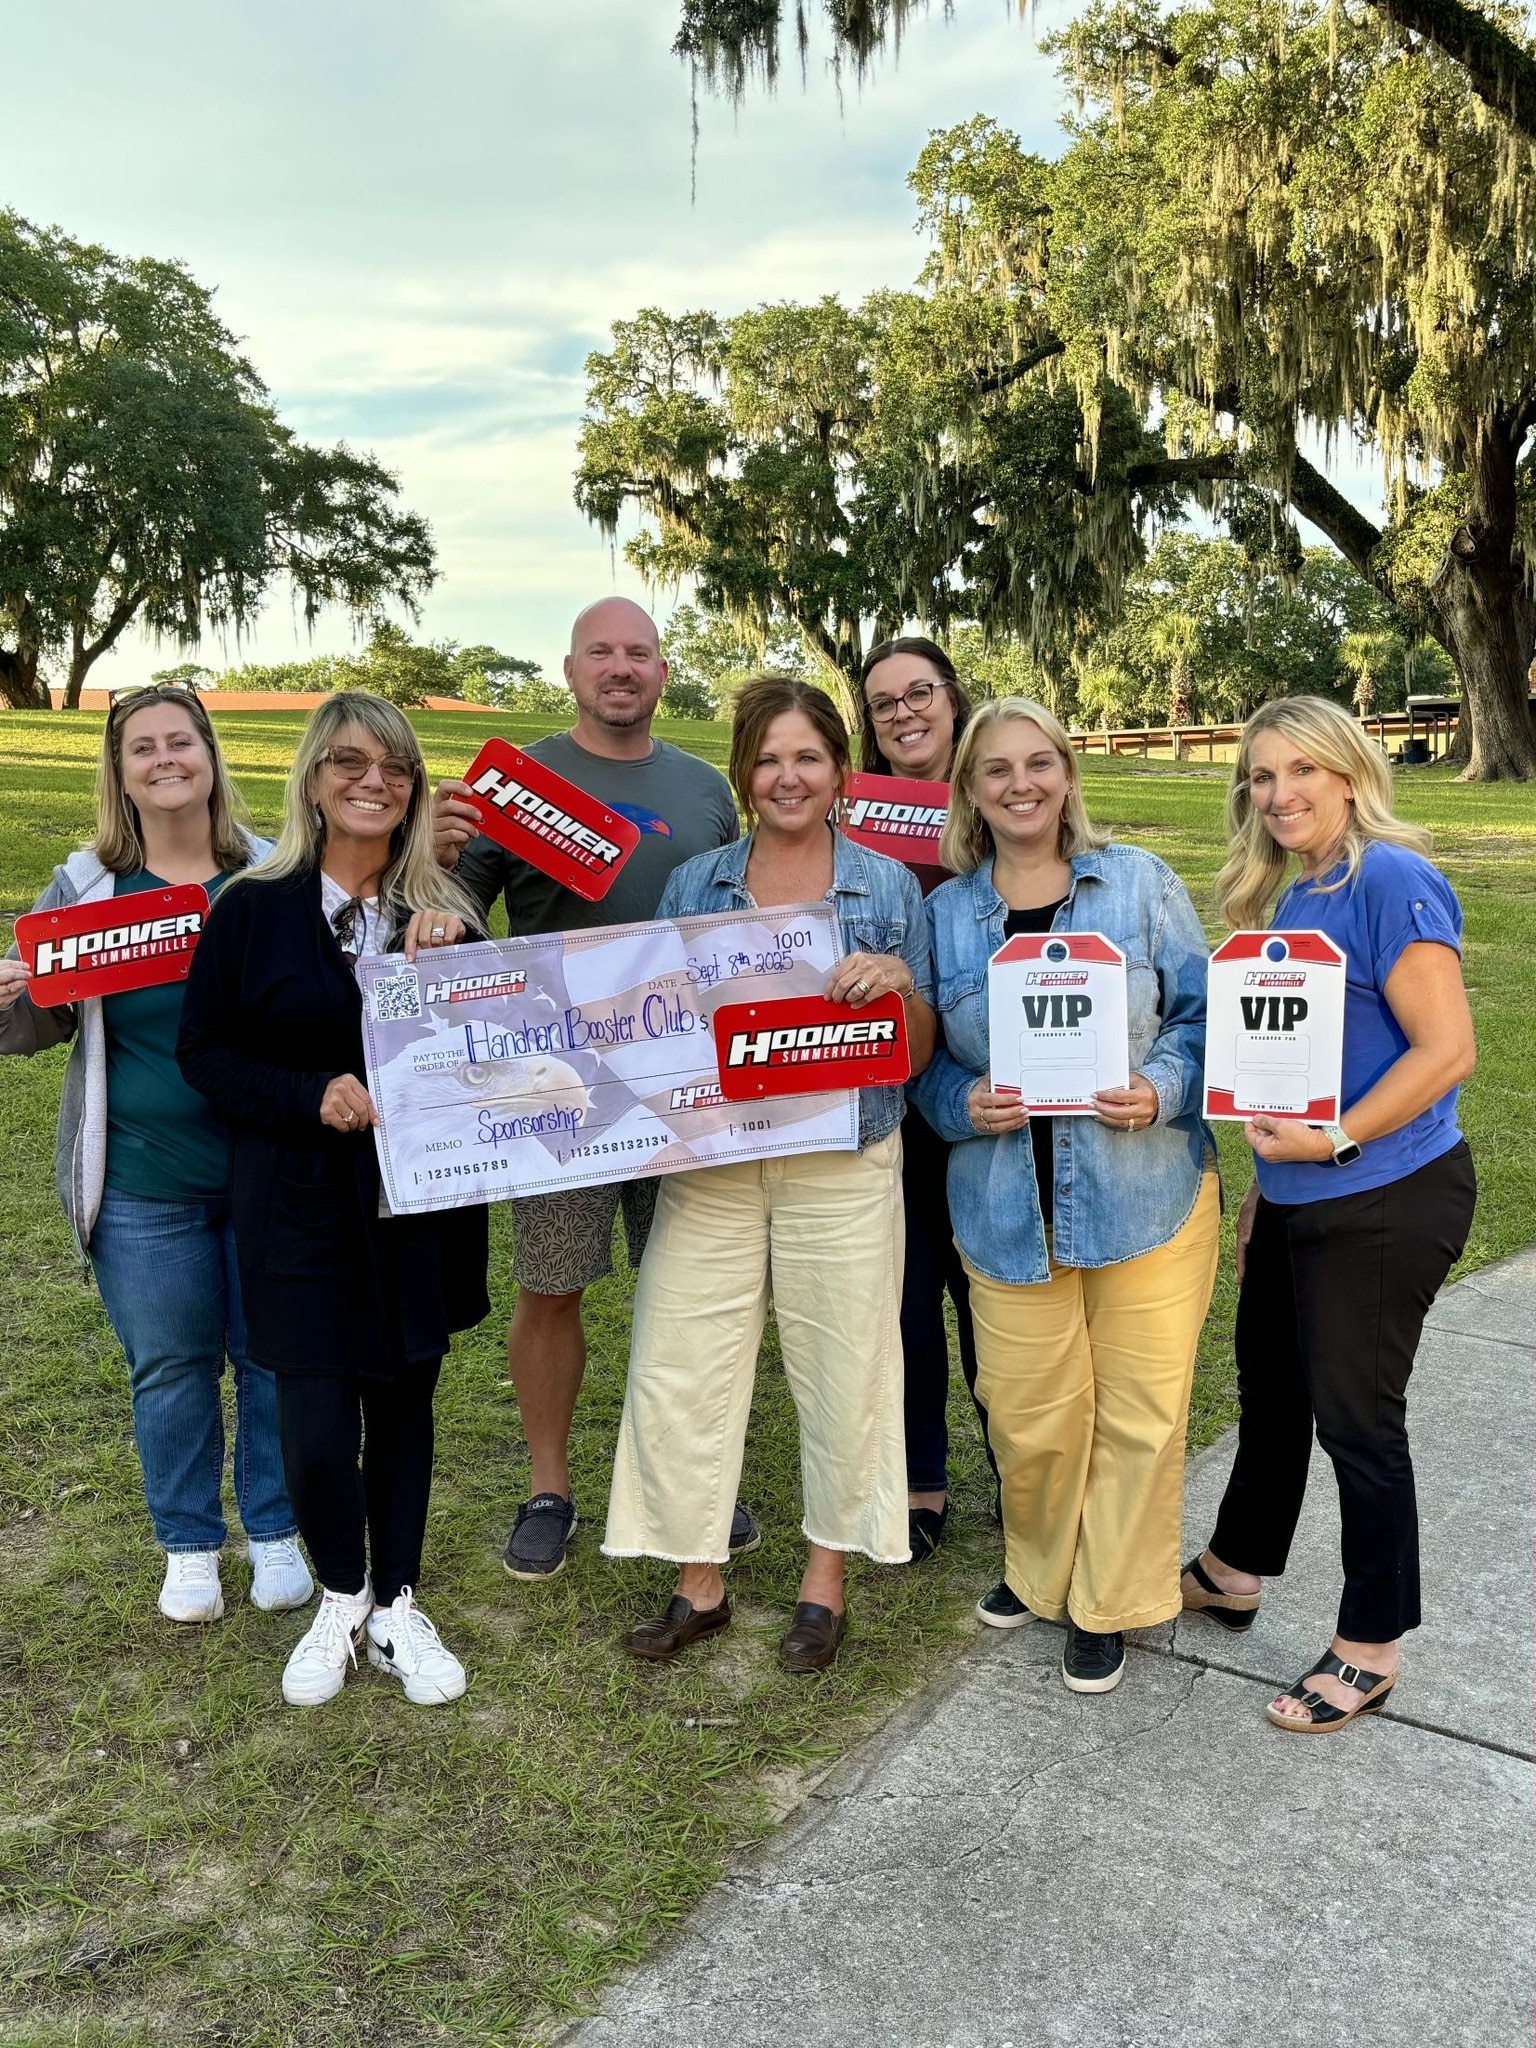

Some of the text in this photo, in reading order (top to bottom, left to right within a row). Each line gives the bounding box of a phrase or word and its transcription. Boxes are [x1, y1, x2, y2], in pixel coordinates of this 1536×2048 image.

[471, 767, 621, 865] HOOVER
[827, 796, 948, 826] HOOVE
[513, 809, 597, 867] SUMMERVILLE
[36, 912, 202, 976] HOOVER
[91, 936, 188, 967] SUMMERVILLE
[772, 930, 813, 950] 1001
[728, 951, 751, 976] 8th
[754, 950, 794, 973] 2025
[425, 970, 527, 1005] HOOVER
[648, 979, 678, 991] DATE
[1025, 971, 1089, 985] HOOVER
[1244, 971, 1307, 986] HOOVER
[458, 984, 517, 1001] SUMMERVILLE
[699, 1013, 709, 1031] $
[1021, 994, 1093, 1029] VIP
[1240, 996, 1309, 1031] VIP
[464, 993, 695, 1064] Hanahan Booster Club
[413, 1049, 465, 1063] PAY TO THE
[728, 1020, 896, 1067] HOOVER
[782, 1042, 879, 1064] SUMMERVILLE
[414, 1060, 459, 1073] ORDER OF
[671, 1082, 722, 1109] HOO
[477, 1103, 584, 1150] Sponsorship
[742, 1119, 772, 1132] 1001
[425, 1139, 463, 1153] MEMO
[428, 1158, 509, 1181] 123456789
